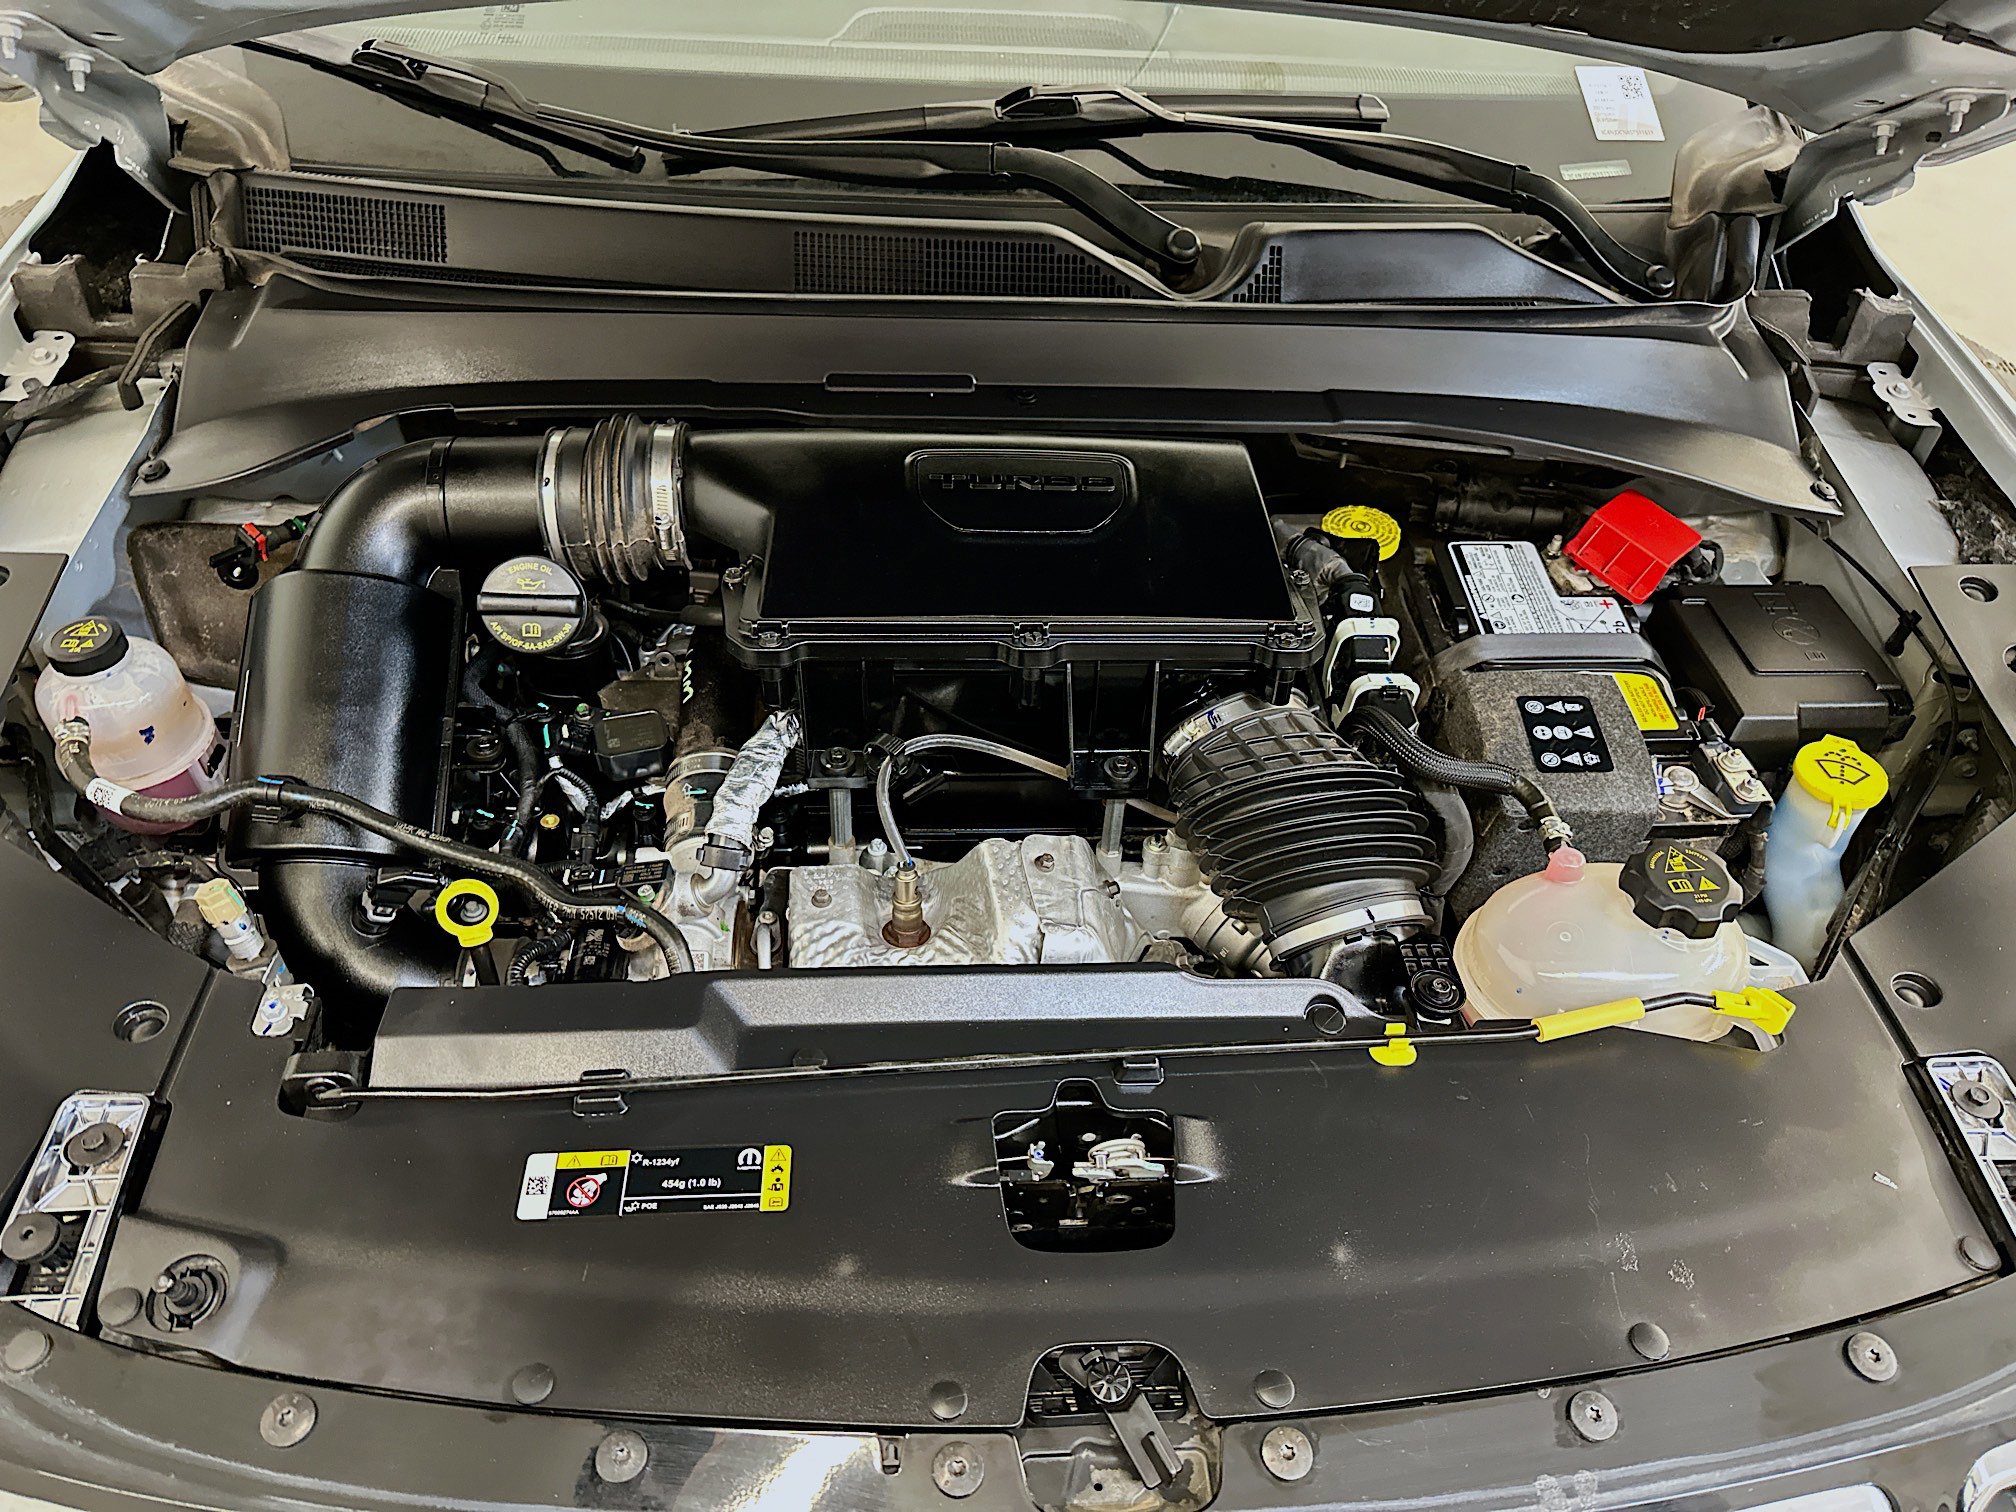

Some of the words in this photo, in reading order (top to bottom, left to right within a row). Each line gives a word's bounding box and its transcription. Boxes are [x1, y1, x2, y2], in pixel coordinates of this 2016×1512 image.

[928, 474, 1116, 492] TURBO
[507, 562, 538, 575] ENGINE
[539, 564, 553, 576] OIL
[490, 621, 504, 635] API
[535, 891, 559, 913] HEATER
[642, 1157, 680, 1168] R-1234yf
[661, 1180, 686, 1190] 454g
[688, 1178, 707, 1189] (1.0
[708, 1177, 722, 1189] lb)
